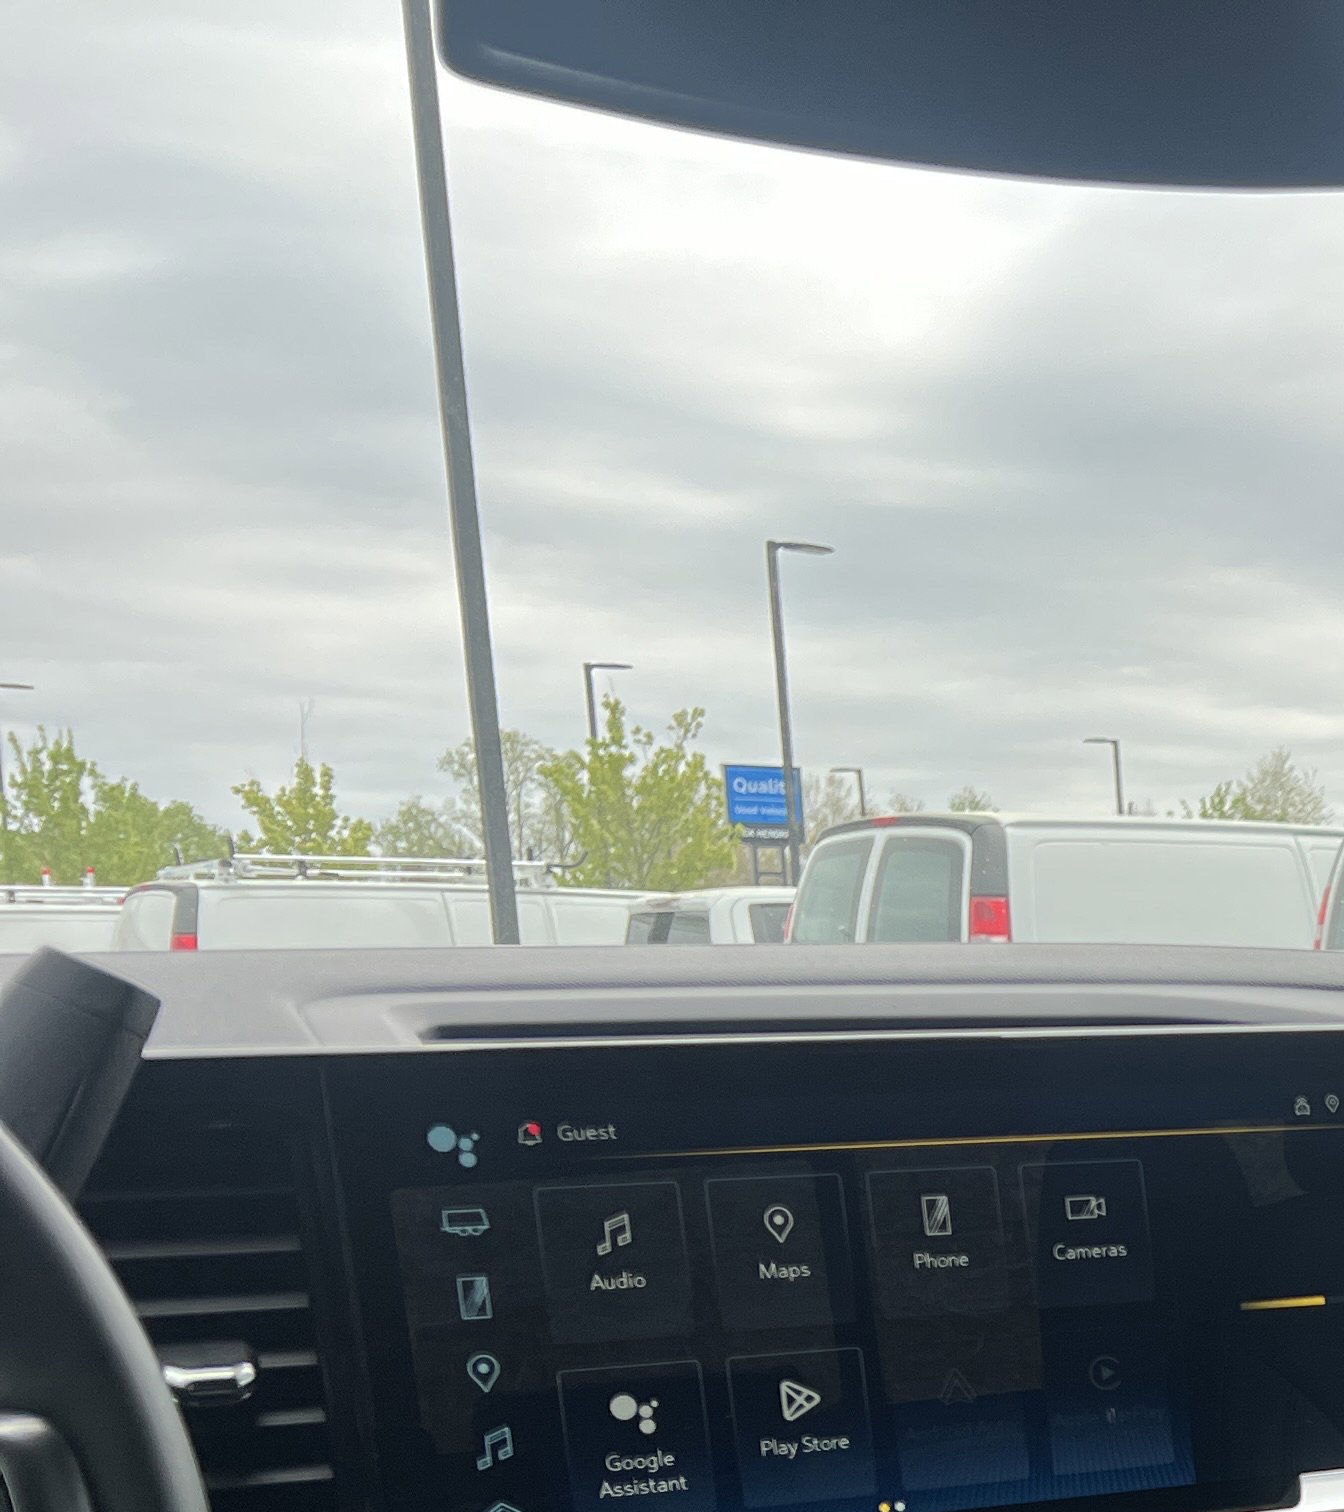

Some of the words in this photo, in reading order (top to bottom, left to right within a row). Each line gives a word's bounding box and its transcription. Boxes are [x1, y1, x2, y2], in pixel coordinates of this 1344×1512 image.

[733, 776, 786, 796] Qualit
[557, 1122, 618, 1142] Guest
[913, 1252, 969, 1269] Phone
[1052, 1243, 1128, 1261] Cameras
[590, 1271, 647, 1291] Audio
[758, 1262, 811, 1282] Maps
[760, 1438, 798, 1459] Play
[801, 1435, 850, 1453] Store
[605, 1448, 676, 1473] Google
[599, 1475, 689, 1499] Assistant
